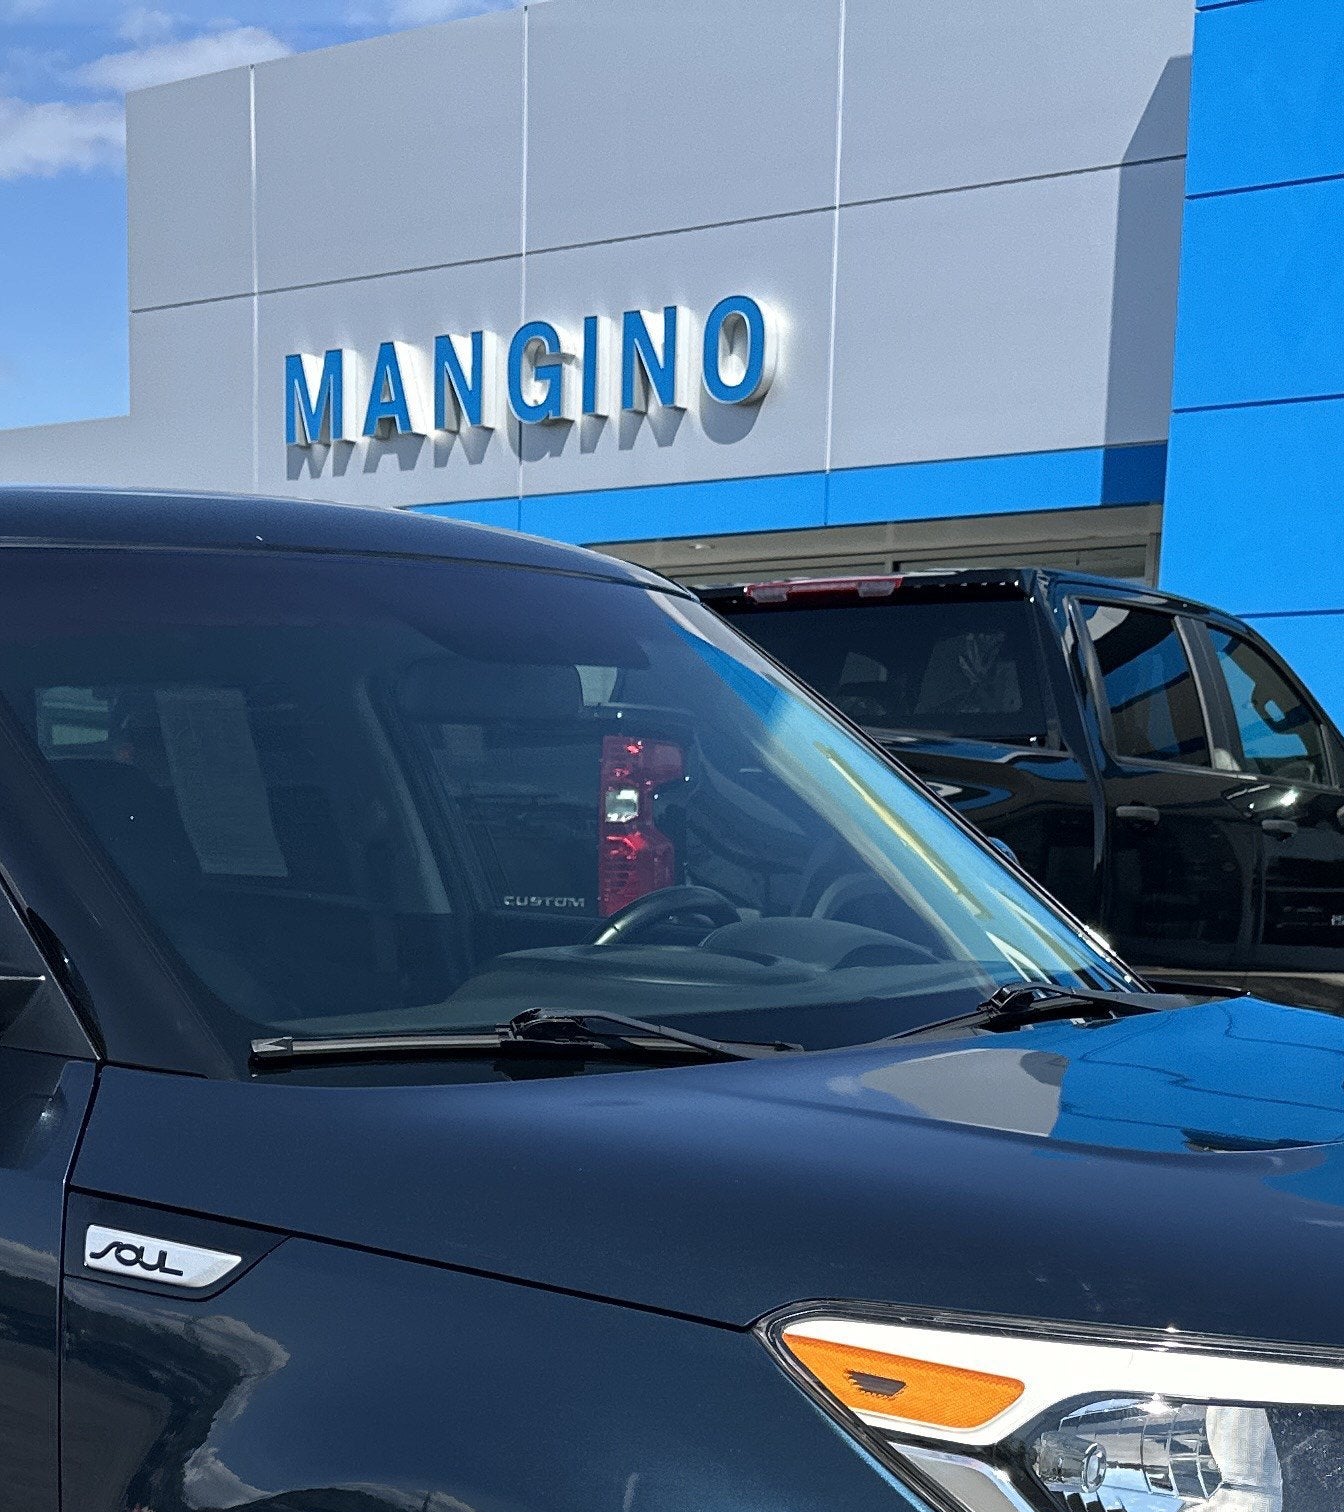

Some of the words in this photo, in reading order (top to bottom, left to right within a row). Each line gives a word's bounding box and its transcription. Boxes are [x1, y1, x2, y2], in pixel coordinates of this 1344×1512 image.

[285, 294, 770, 446] MANGINO
[503, 895, 585, 907] CUSTOM
[89, 1241, 184, 1277] SOUL
